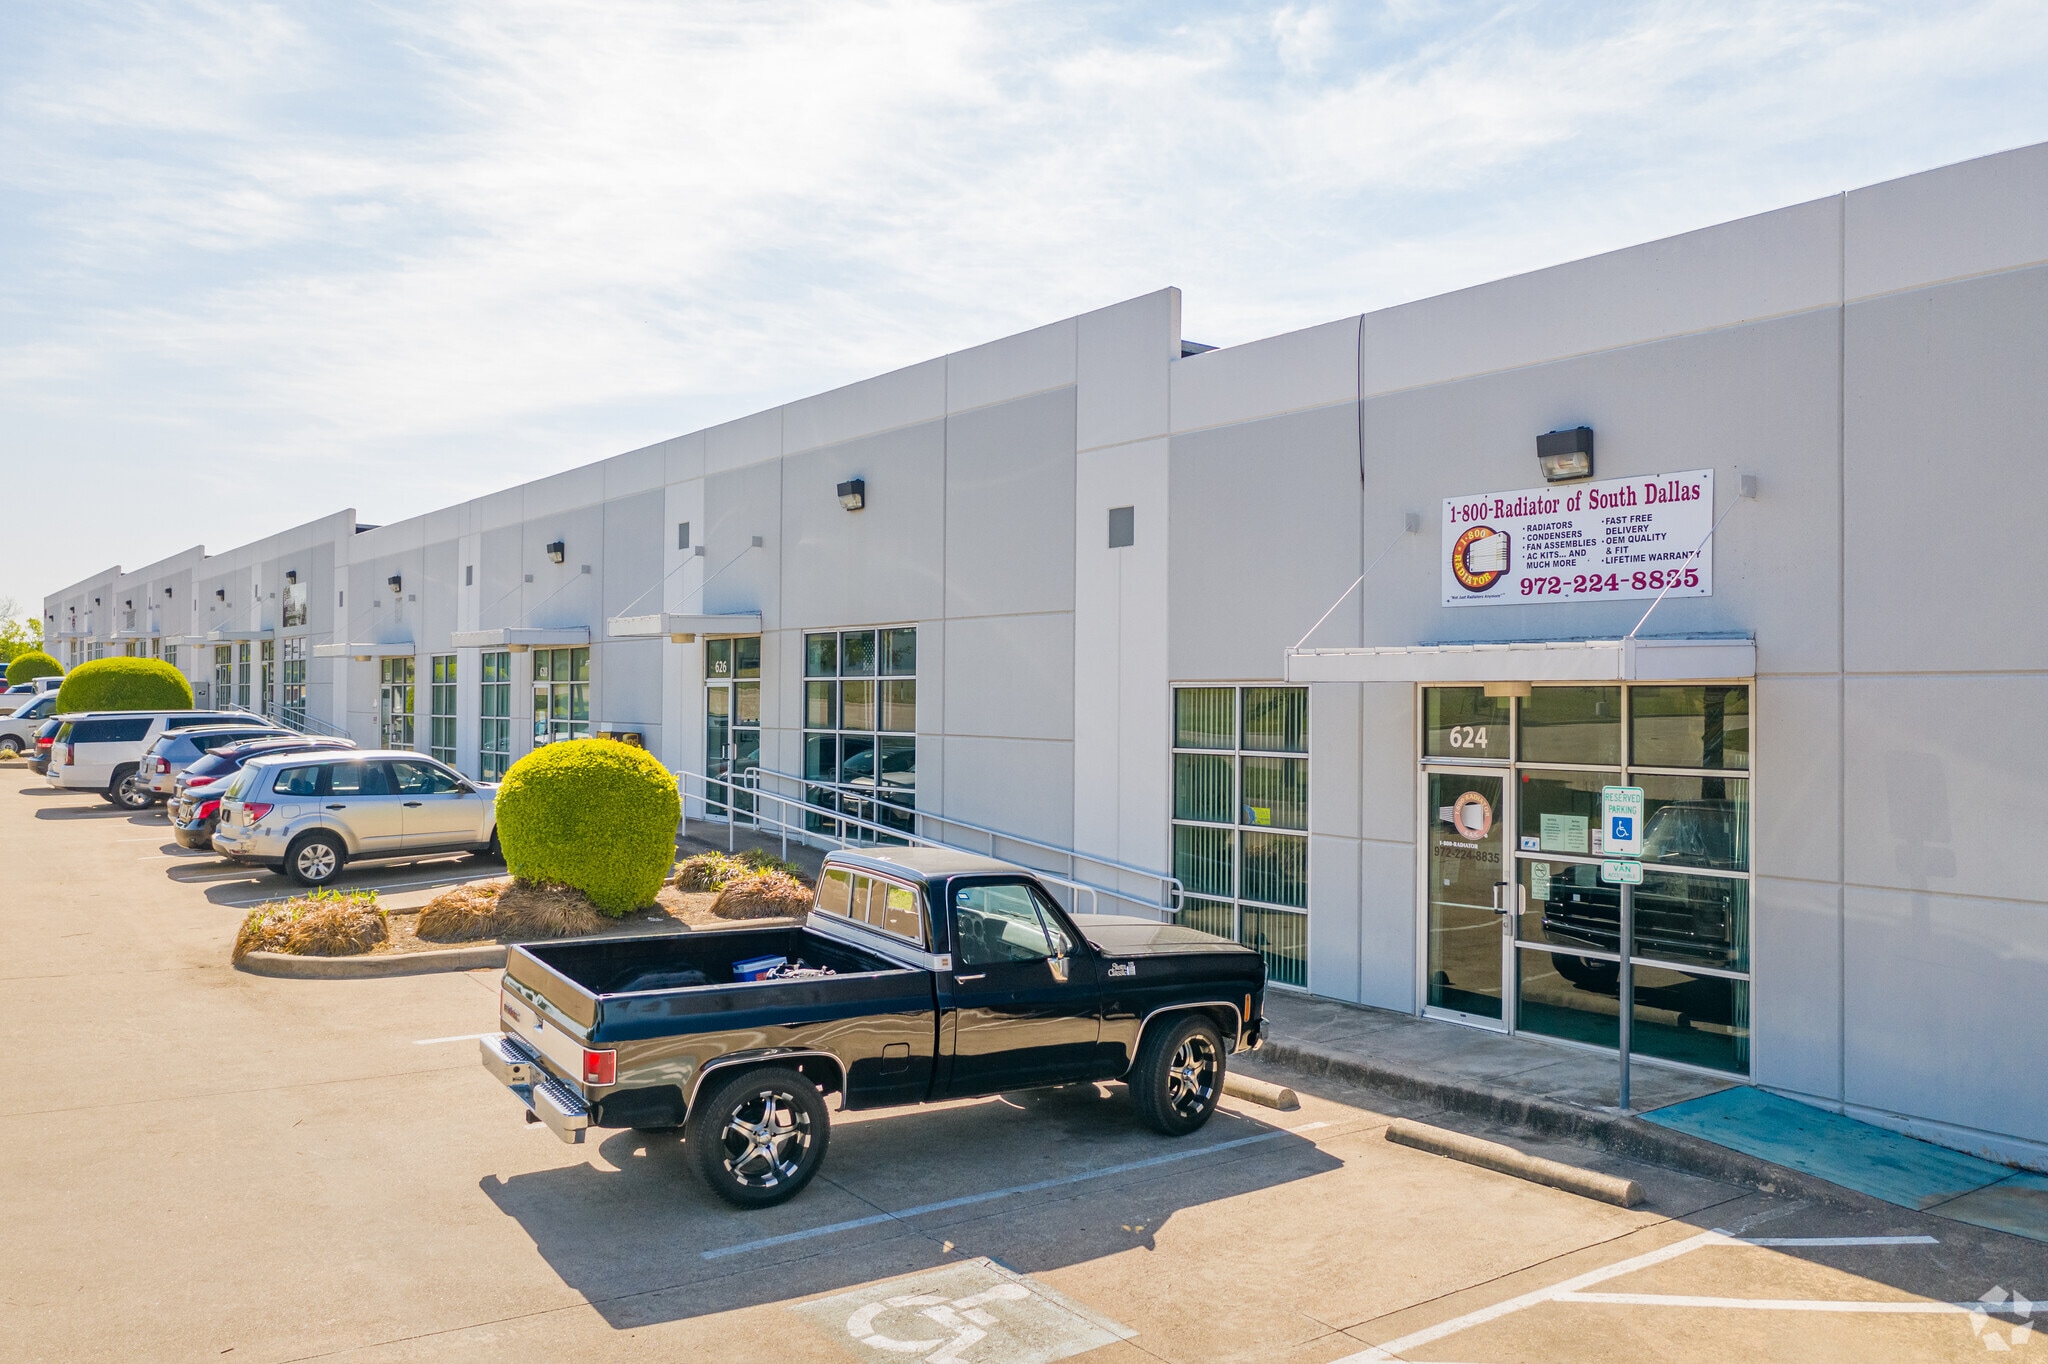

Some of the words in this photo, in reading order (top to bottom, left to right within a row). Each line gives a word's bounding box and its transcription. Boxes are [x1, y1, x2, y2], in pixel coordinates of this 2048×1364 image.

[1450, 496, 1560, 523] 1-800-Radiator
[1566, 490, 1582, 512] of
[1588, 485, 1637, 510] South
[1644, 480, 1700, 505] Dallas
[1605, 516, 1627, 525] FAST
[1630, 513, 1653, 523] FREE
[1526, 521, 1573, 532] RADIATORS
[1605, 524, 1649, 535] DELIVERY
[1526, 530, 1583, 542] CONDENSERS
[1605, 536, 1625, 545] OEM
[1627, 532, 1667, 543] QUALITY
[1526, 543, 1542, 551] FAN
[1544, 538, 1597, 550] ASSEMBLIES
[1605, 547, 1612, 555] &
[1615, 546, 1629, 554] FIT
[1526, 552, 1538, 561] AC
[1540, 551, 1567, 559] KITS...
[1569, 548, 1587, 558] AND
[1605, 554, 1646, 565] LIFETIME
[1648, 550, 1701, 562] WARRANTY
[1454, 554, 1492, 586] RADIATOR
[1526, 561, 1551, 570] MUCH
[1552, 558, 1577, 568] MORE
[1520, 568, 1699, 596] 972-224-8835
[714, 660, 727, 673] 626
[1450, 726, 1488, 749] 624
[1605, 792, 1641, 803] RESERVED
[1608, 804, 1637, 815] PARKING
[1439, 840, 1479, 849] 1-800-RADIATOR
[1434, 846, 1500, 864] 972-224-8835
[1613, 865, 1631, 873] VAN
